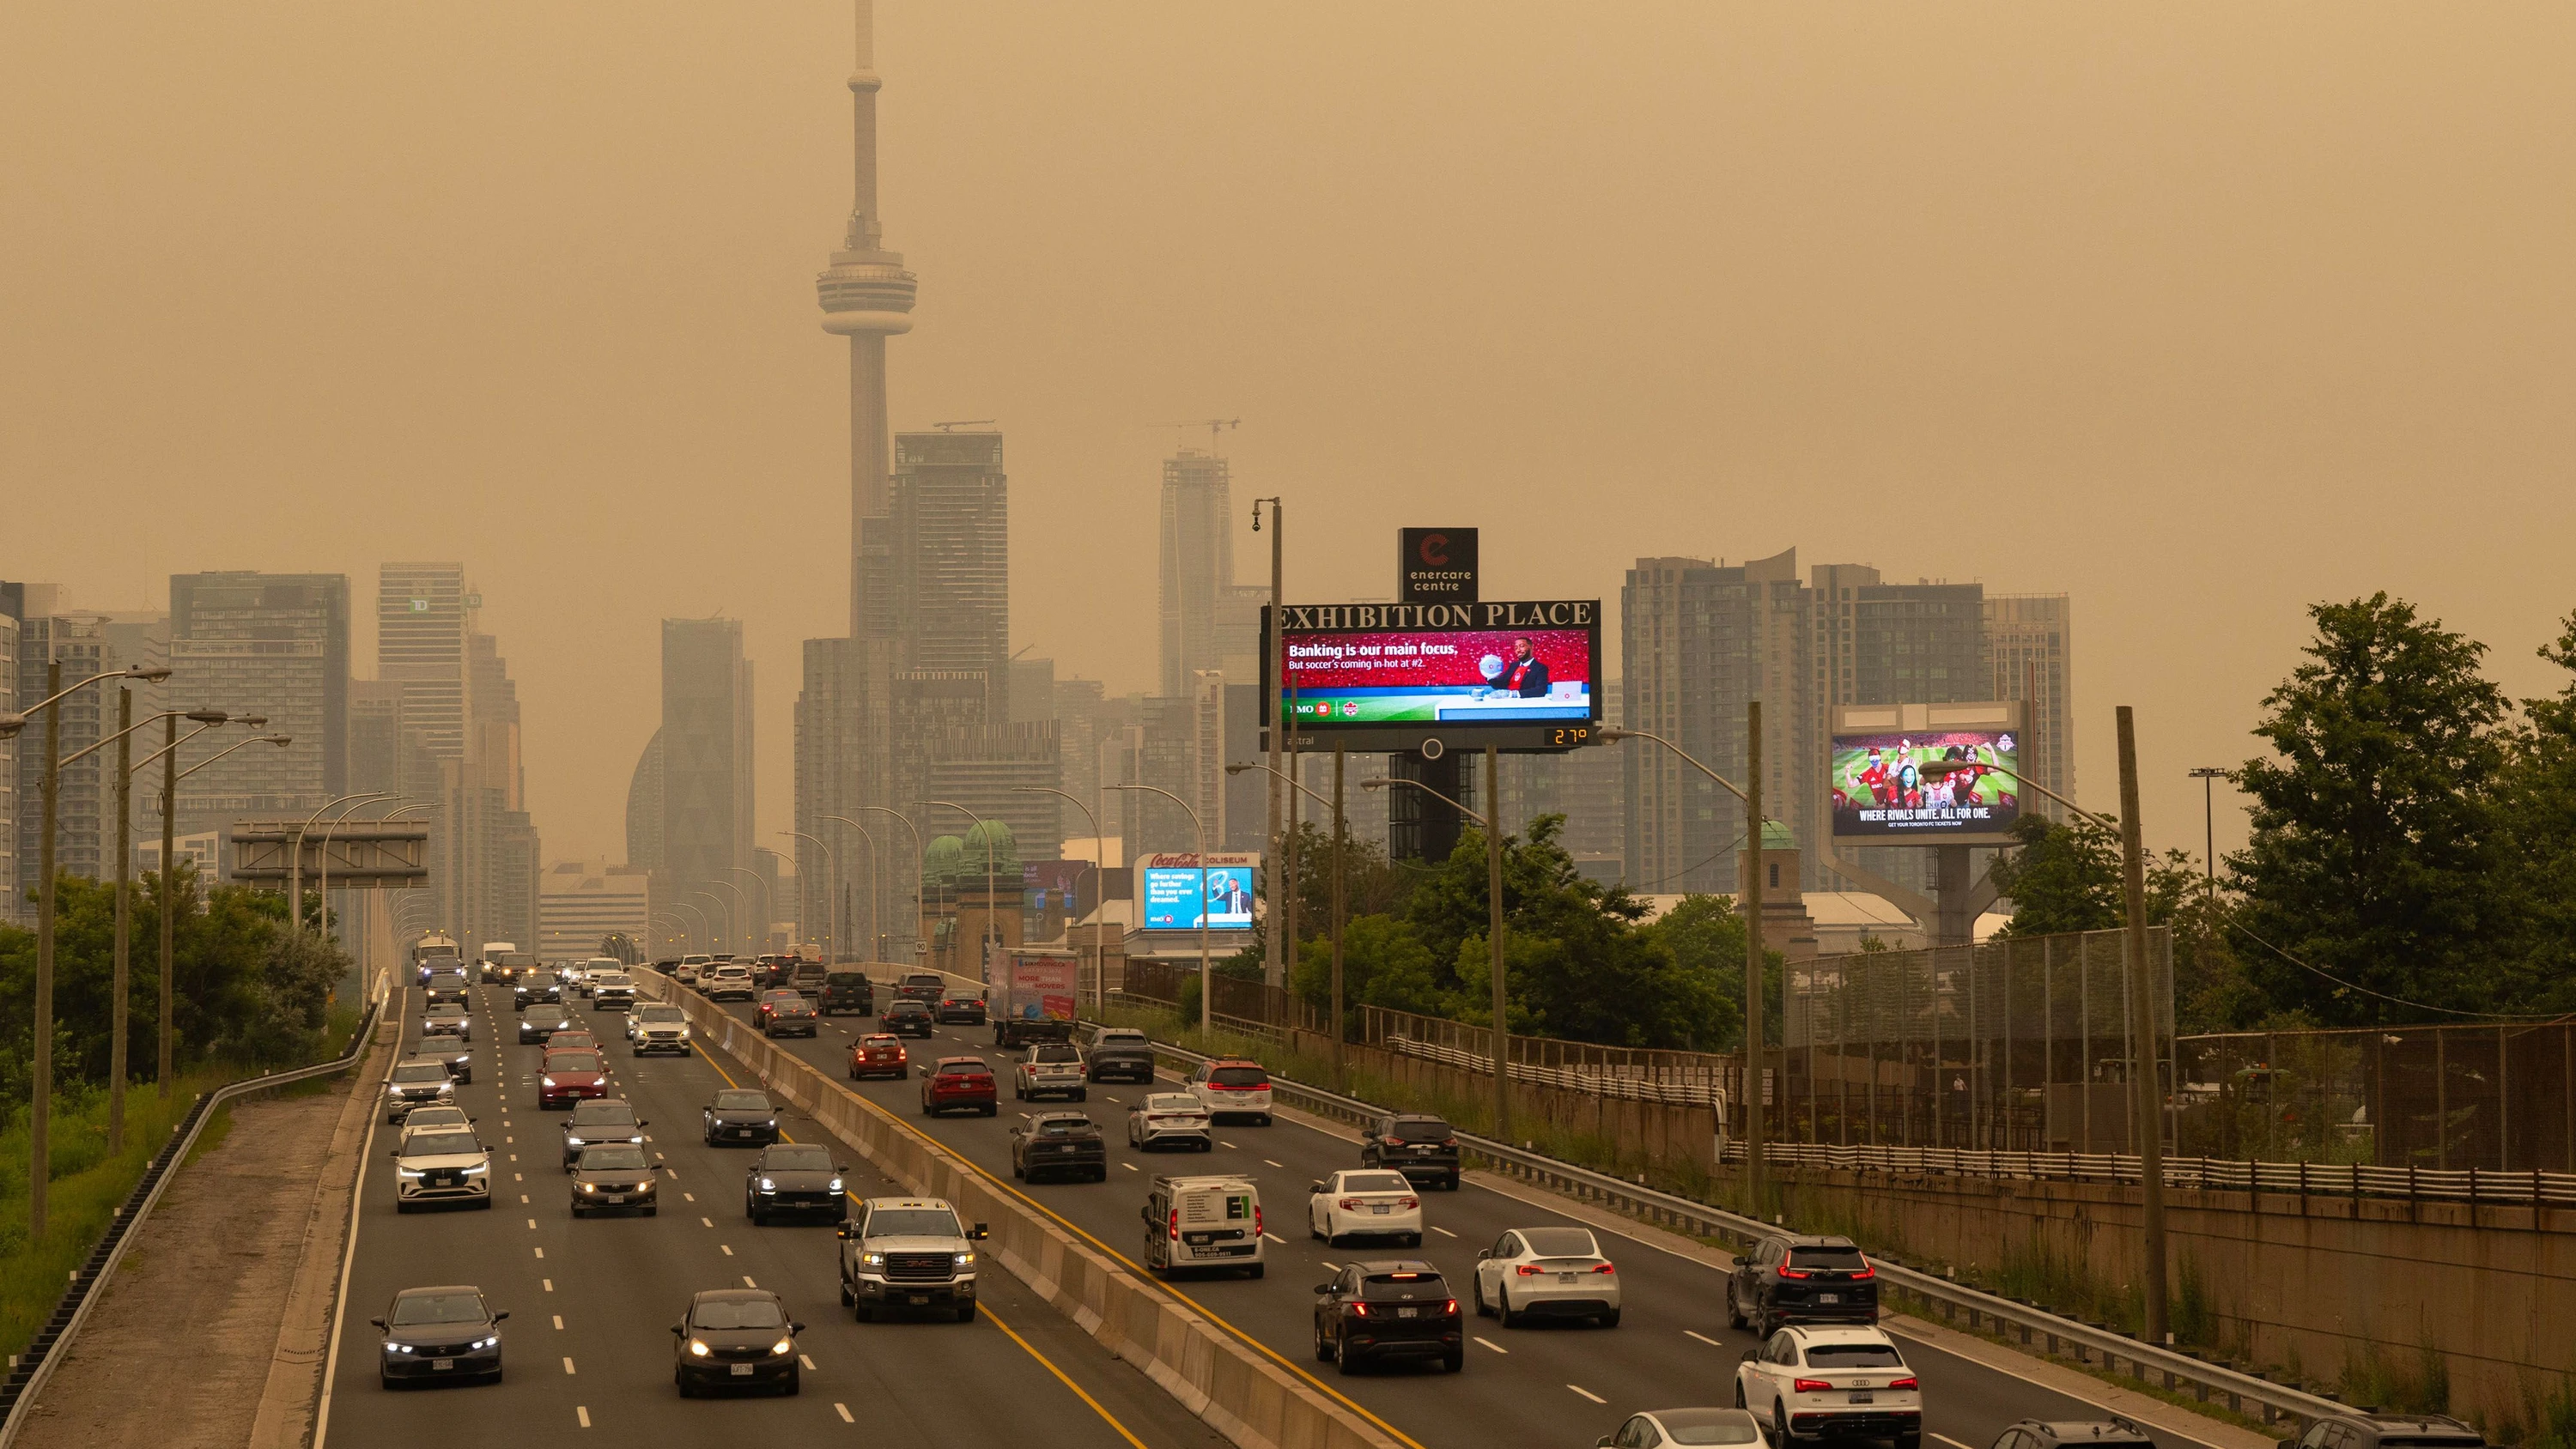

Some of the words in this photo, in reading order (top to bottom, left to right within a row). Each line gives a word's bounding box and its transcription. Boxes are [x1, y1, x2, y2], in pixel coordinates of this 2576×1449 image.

[1410, 572, 1472, 580] enercare
[1413, 581, 1460, 591] centre
[412, 599, 428, 611] TD
[1281, 604, 1473, 629] EXHIBITION
[1485, 602, 1592, 627] PLACE
[1289, 644, 1342, 659] Banking
[1346, 644, 1357, 656] is
[1359, 646, 1381, 656] our
[1384, 643, 1417, 656] main
[1289, 661, 1303, 670] But
[1305, 659, 1339, 669] soccer's
[1340, 659, 1372, 670] coming
[1374, 659, 1382, 668] in
[1384, 659, 1398, 668] hot
[1287, 737, 1314, 745] atral
[1859, 809, 1886, 822] WHERE
[1887, 809, 1914, 821] RIVALS
[1915, 809, 1940, 820] UNITE.
[1941, 809, 1955, 820] ALL
[1956, 808, 1971, 819] FOR
[1972, 808, 1991, 819] ONE.
[1226, 1196, 1250, 1219] E1
